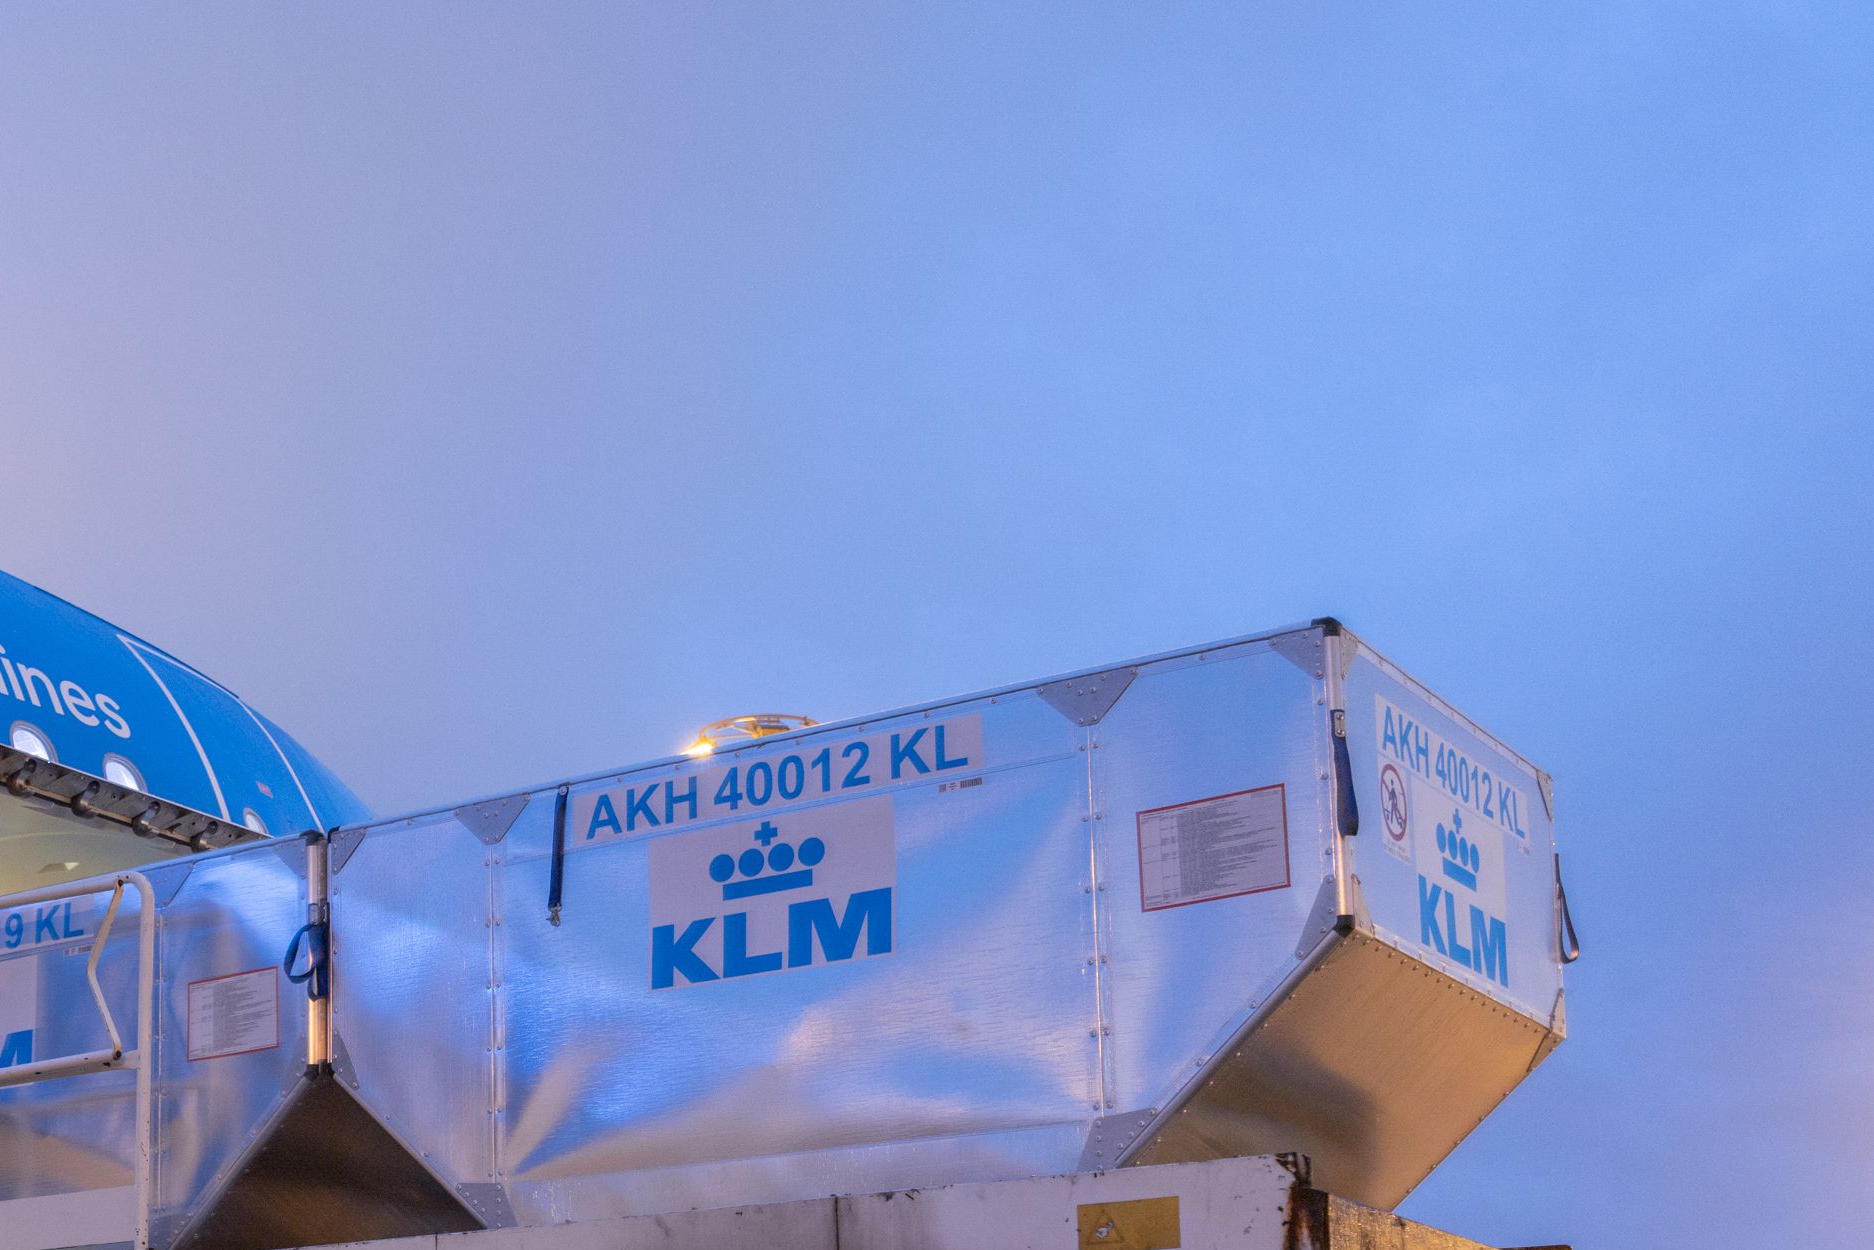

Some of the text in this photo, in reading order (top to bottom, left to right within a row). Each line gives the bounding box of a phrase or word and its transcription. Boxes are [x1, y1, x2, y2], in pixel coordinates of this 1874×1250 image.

[586, 724, 968, 840] AKH 40012 KL
[1382, 705, 1525, 839] AKH 40012 KL
[34, 902, 84, 944] KL
[651, 886, 892, 989] KLM
[1418, 872, 1509, 989] KLM
